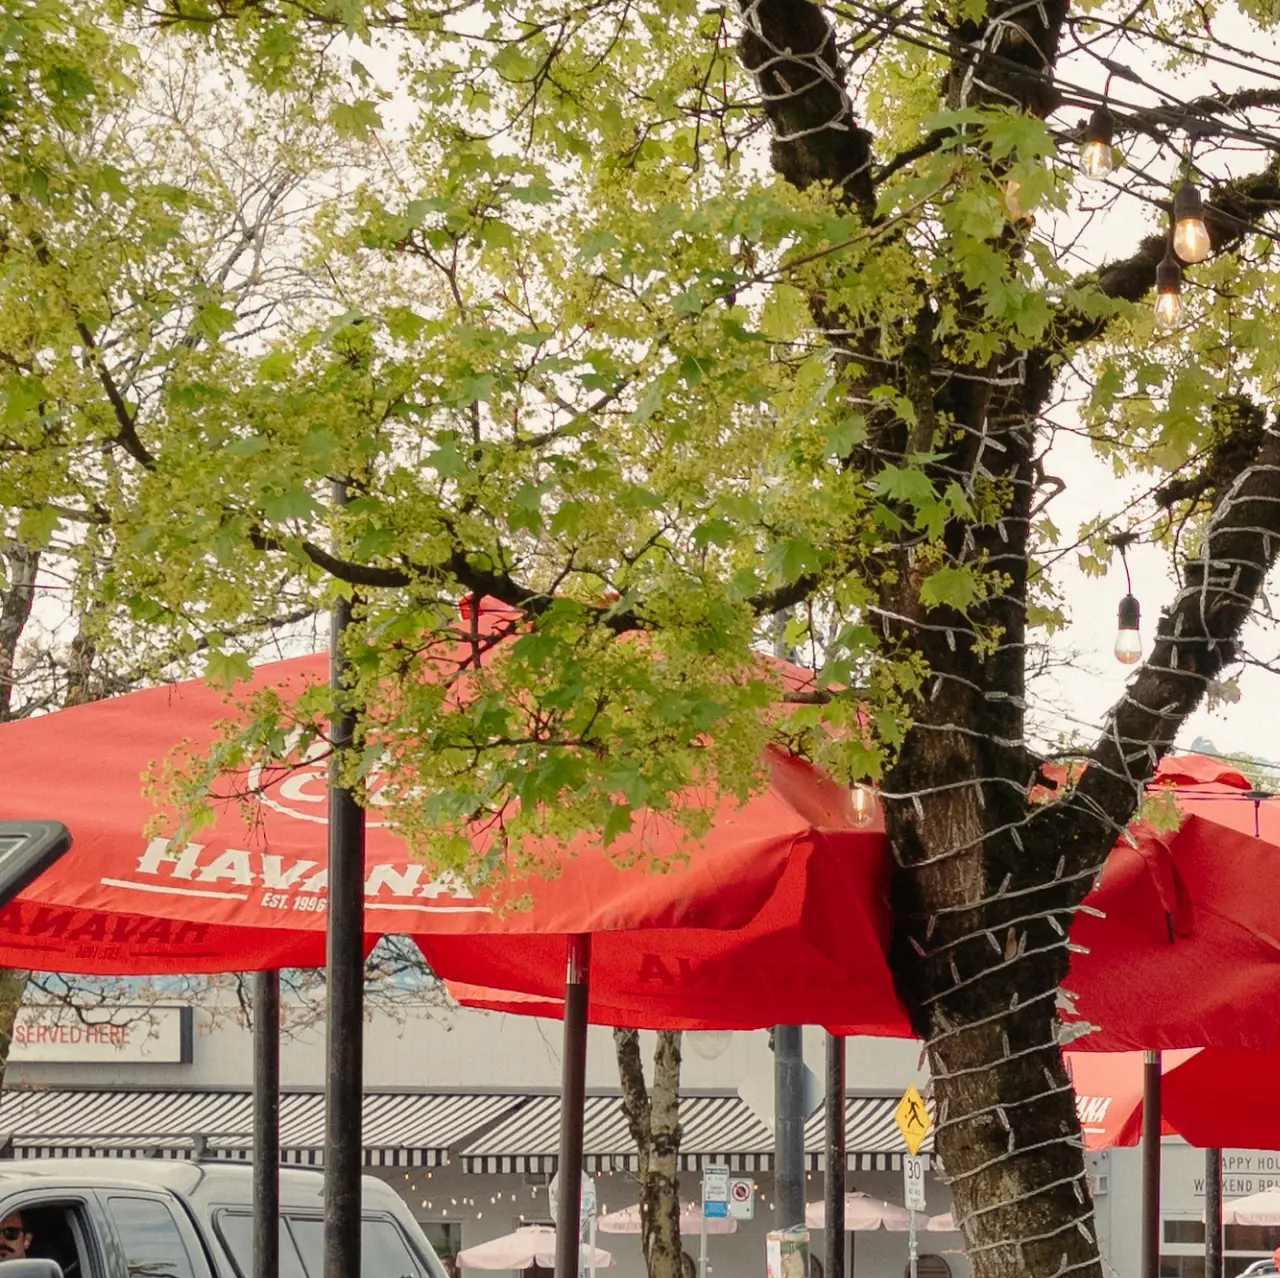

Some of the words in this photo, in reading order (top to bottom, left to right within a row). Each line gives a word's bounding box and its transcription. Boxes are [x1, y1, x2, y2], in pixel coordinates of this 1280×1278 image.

[14, 1026, 83, 1045] SERVED
[85, 1026, 130, 1045] HERE
[907, 1160, 921, 1180] 30
[1221, 1157, 1252, 1170] APPY
[1193, 1179, 1253, 1193] WKEND
